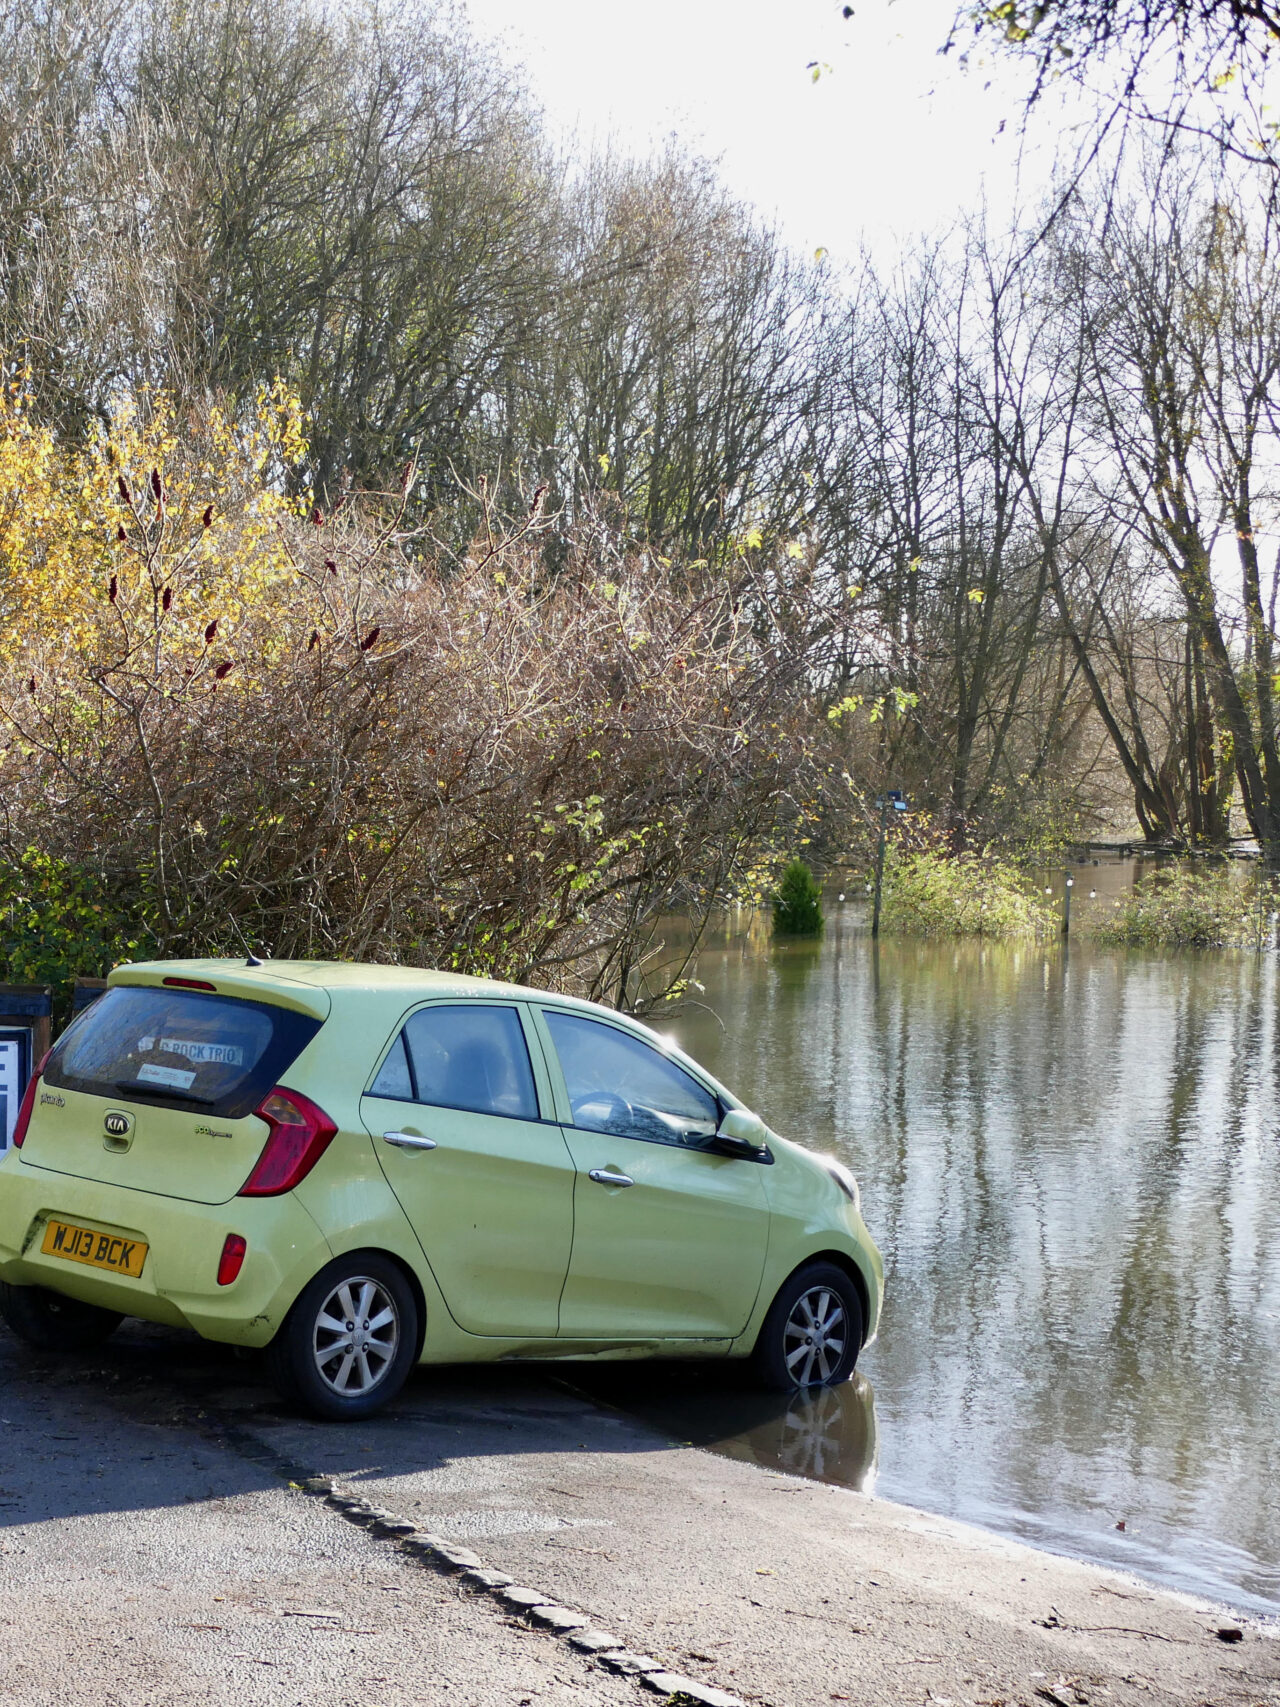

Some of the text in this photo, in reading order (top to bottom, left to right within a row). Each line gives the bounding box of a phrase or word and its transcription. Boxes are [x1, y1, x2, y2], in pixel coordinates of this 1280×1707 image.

[208, 1046, 235, 1062] TRIO
[107, 1117, 125, 1131] KIA
[94, 1237, 136, 1268] BCK
